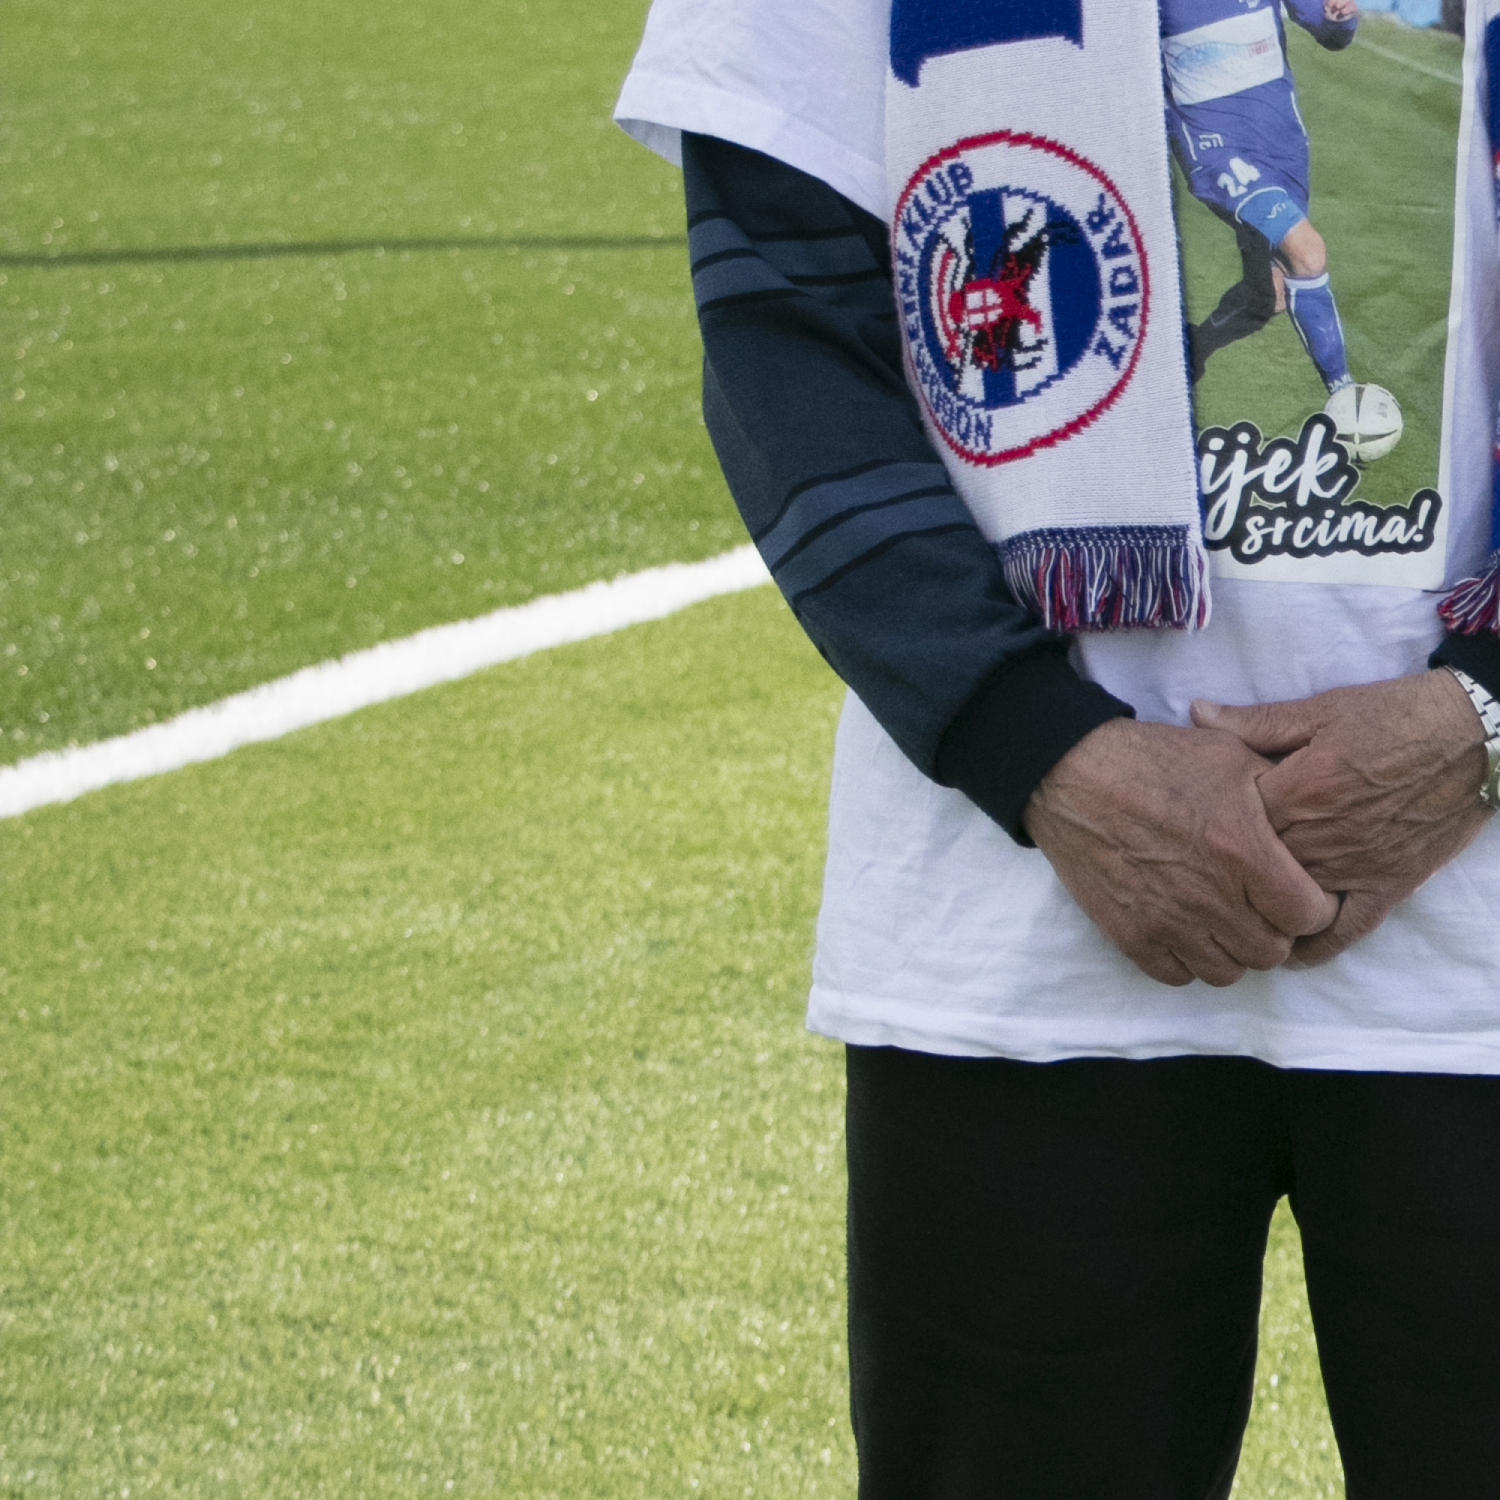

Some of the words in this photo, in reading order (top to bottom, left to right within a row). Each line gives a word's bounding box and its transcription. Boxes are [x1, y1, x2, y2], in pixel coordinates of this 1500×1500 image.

[901, 161, 974, 251] KLUB
[1217, 157, 1261, 198] 24
[1085, 192, 1139, 371] ZADAR
[1201, 423, 1349, 541] ijek
[1241, 499, 1432, 555] srcima!
